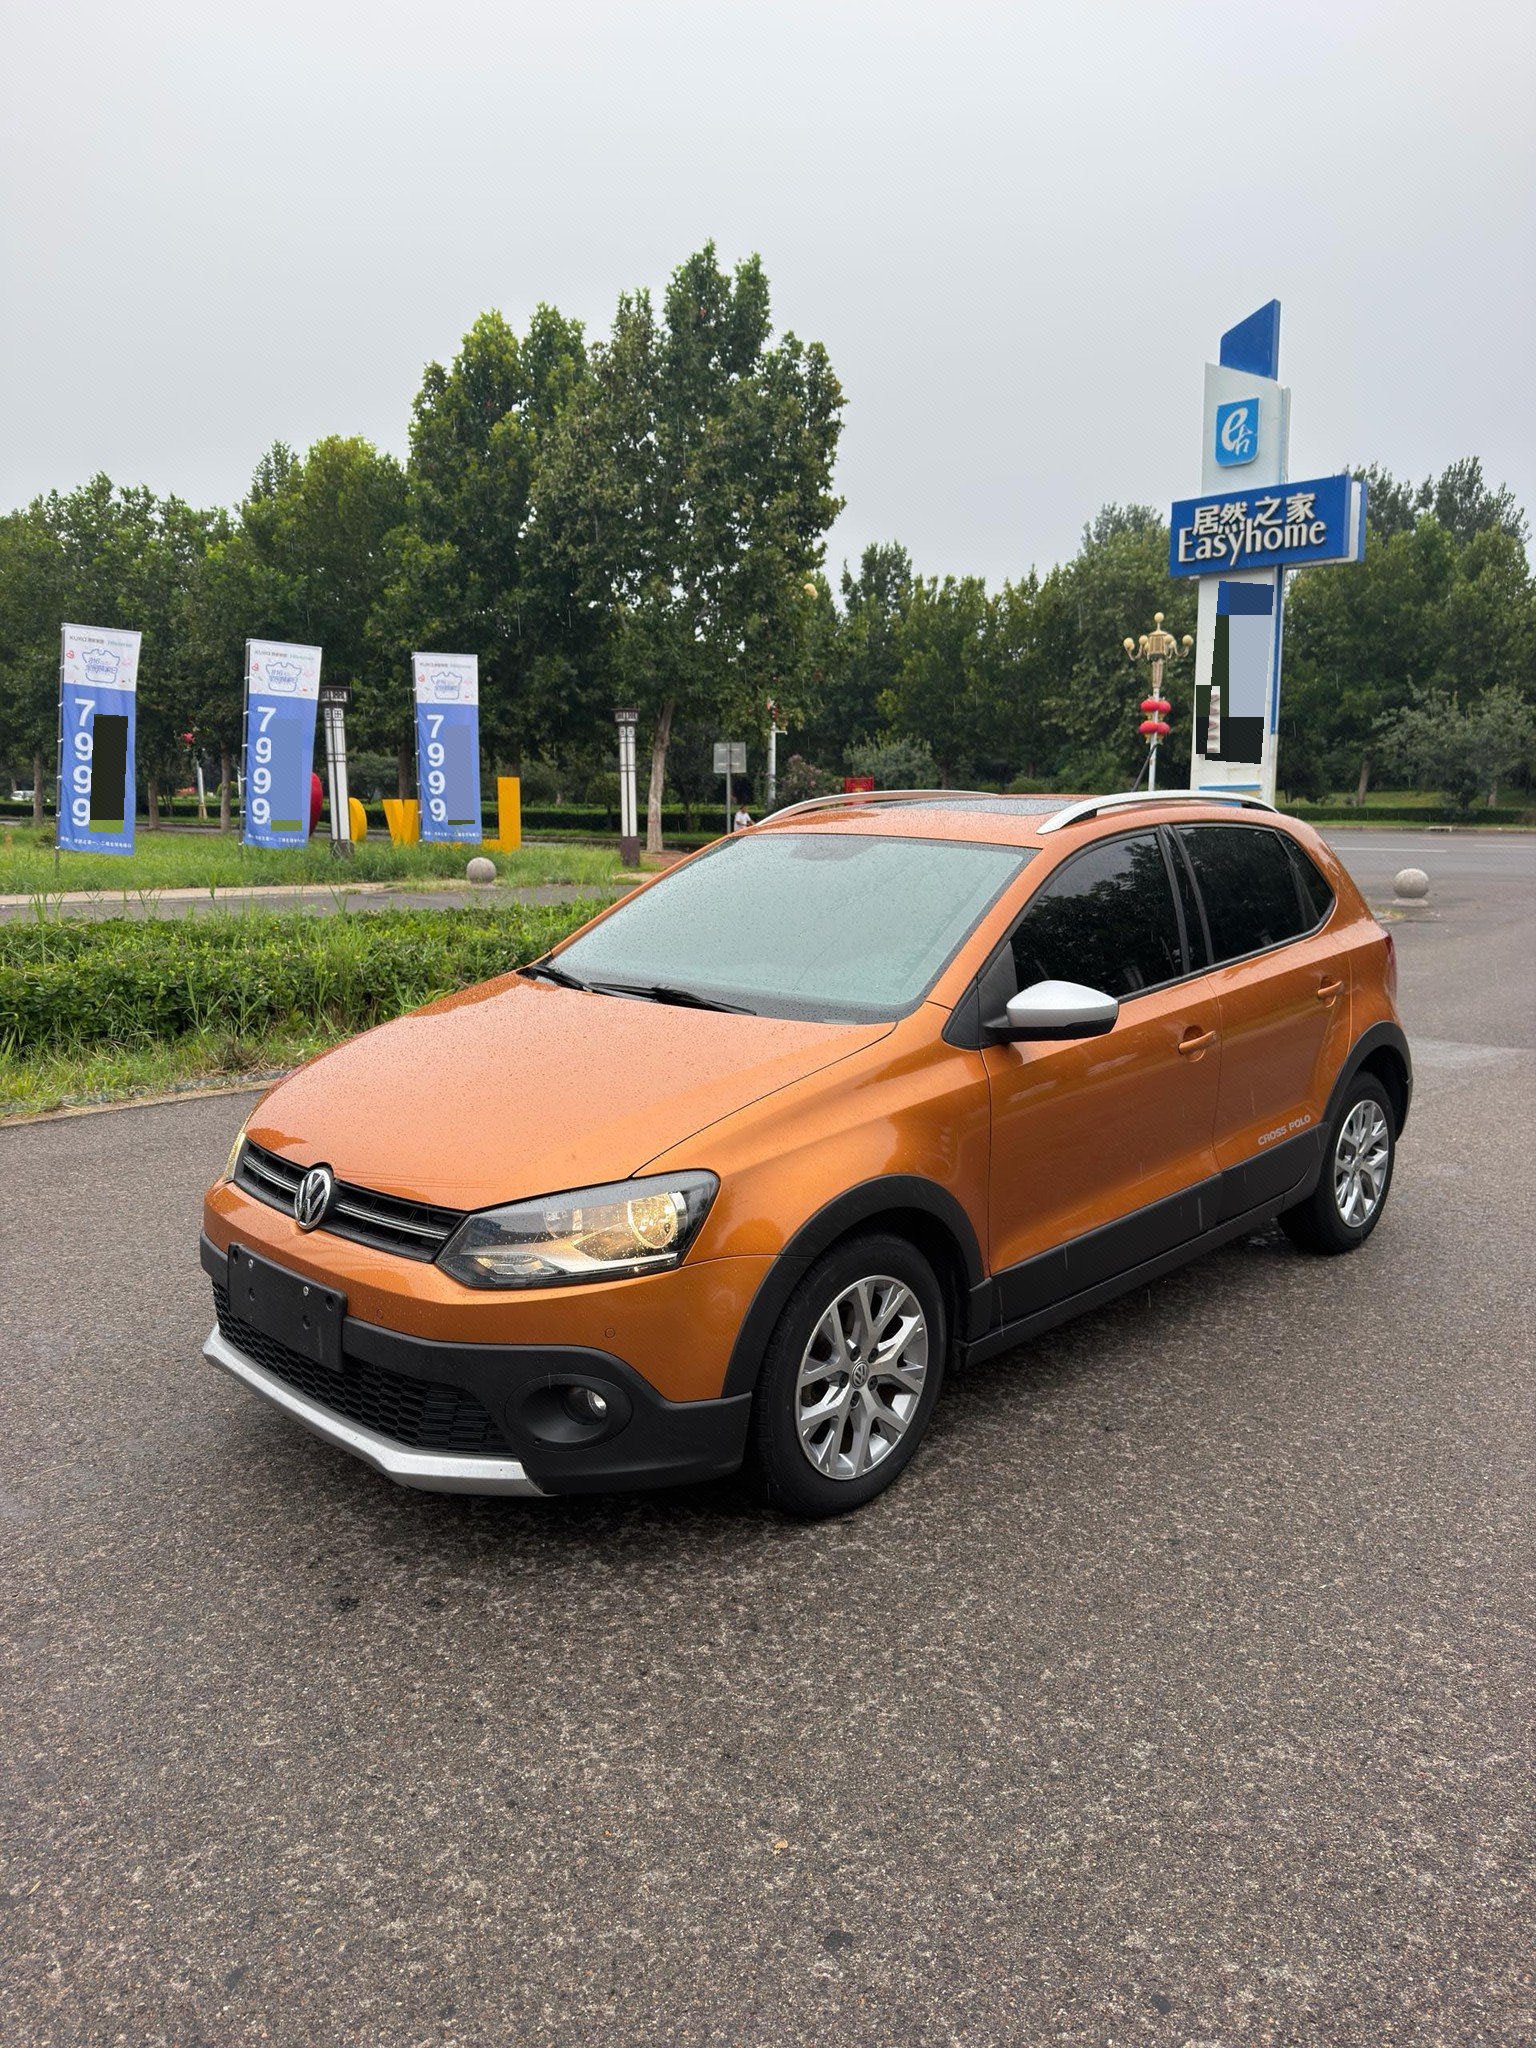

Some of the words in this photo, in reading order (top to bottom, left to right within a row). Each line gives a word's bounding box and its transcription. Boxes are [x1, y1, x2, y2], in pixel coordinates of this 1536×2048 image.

[1178, 518, 1327, 566] Easyhome
[1193, 493, 1316, 536] 居然之家
[72, 698, 96, 827] 7999
[252, 706, 277, 825] 7999
[427, 714, 447, 822] 7999
[1258, 1126, 1287, 1145] CROSS
[1289, 1114, 1311, 1131] POLO
